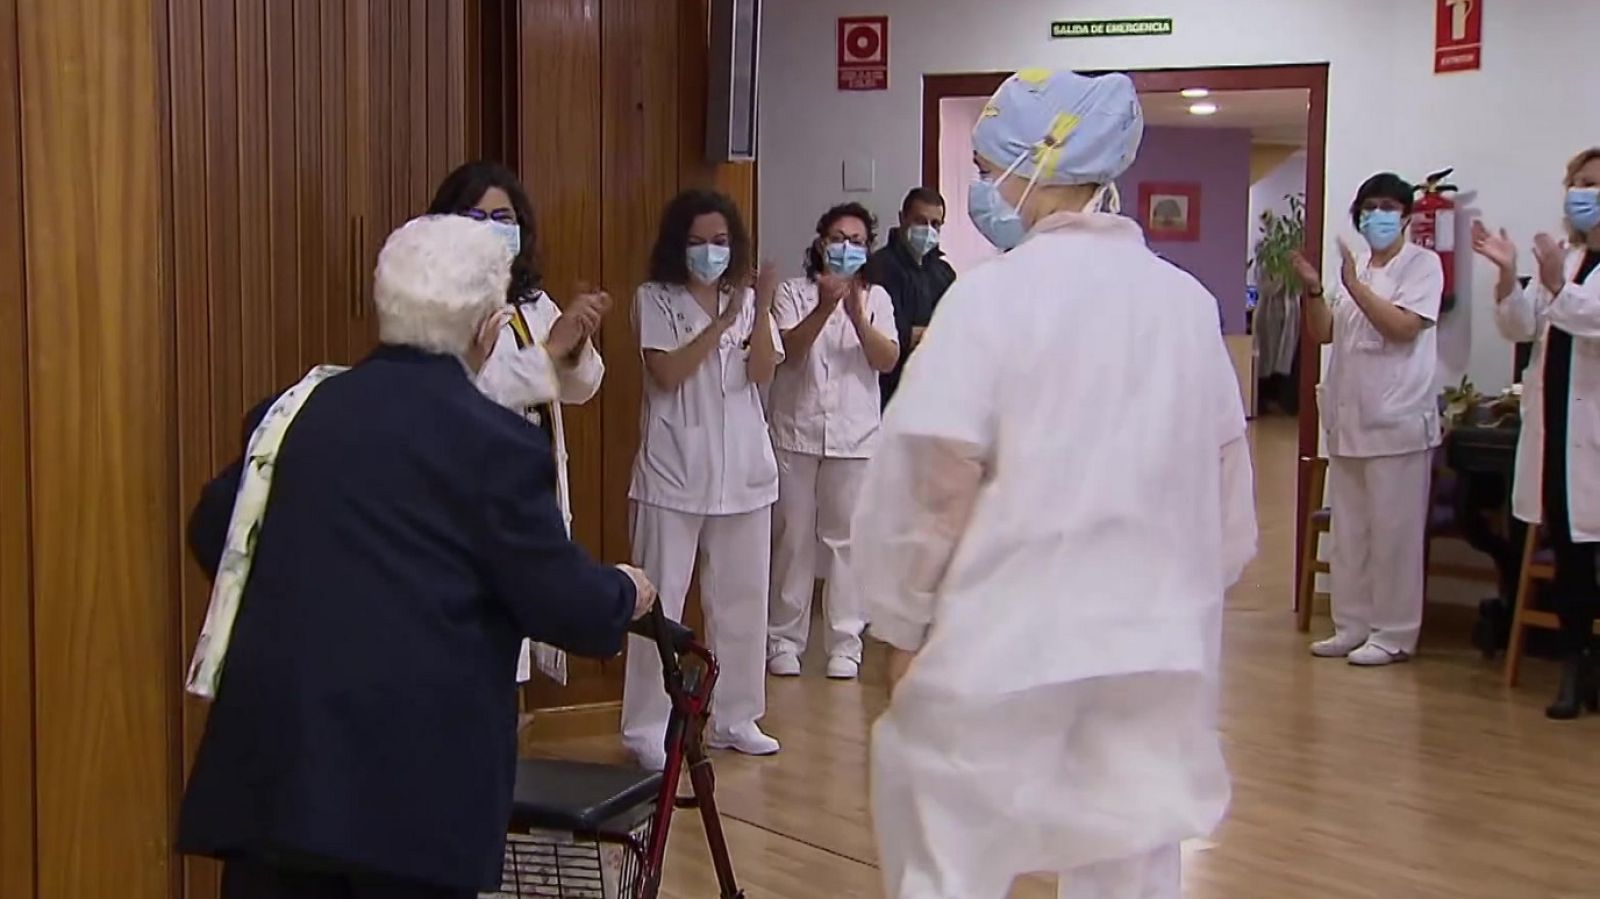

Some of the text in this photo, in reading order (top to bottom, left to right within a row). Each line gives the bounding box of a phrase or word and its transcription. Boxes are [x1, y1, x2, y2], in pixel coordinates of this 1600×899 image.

[1053, 22, 1170, 35] SALIDA DE EMERGENCIA
